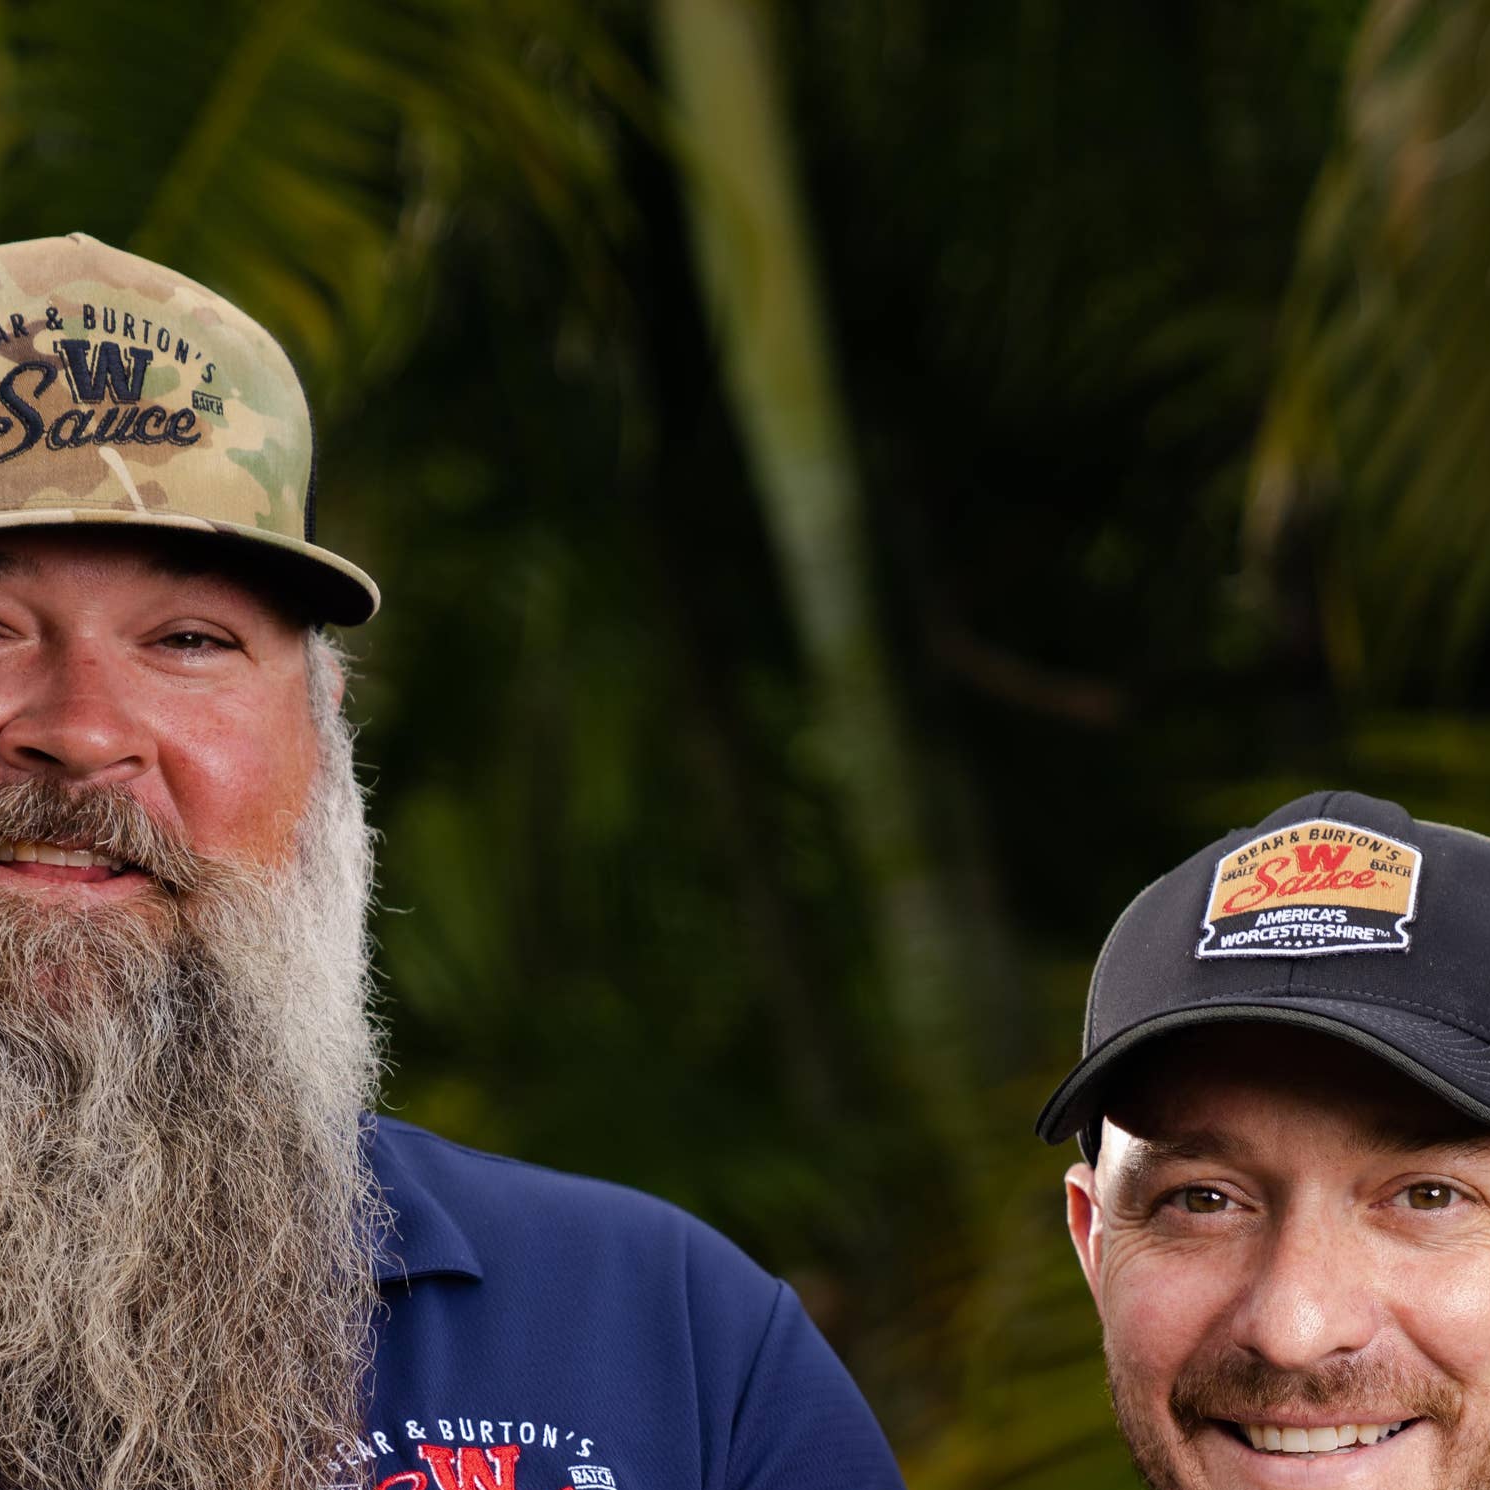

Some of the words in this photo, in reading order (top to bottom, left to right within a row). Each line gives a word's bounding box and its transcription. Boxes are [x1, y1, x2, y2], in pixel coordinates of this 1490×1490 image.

[45, 307, 64, 331] &
[82, 303, 217, 384] BURTON'S
[53, 338, 154, 404] W
[1237, 835, 1284, 865] BEAR
[1289, 831, 1300, 843] &
[1309, 828, 1401, 861] BURTON'S
[1293, 844, 1352, 873] W
[1222, 856, 1377, 914] Sauce
[1220, 923, 1376, 948] WORCESTERSHIRE
[1254, 908, 1348, 928] AMERICA'S
[405, 1419, 427, 1439] &
[438, 1417, 594, 1458] BURTON'S
